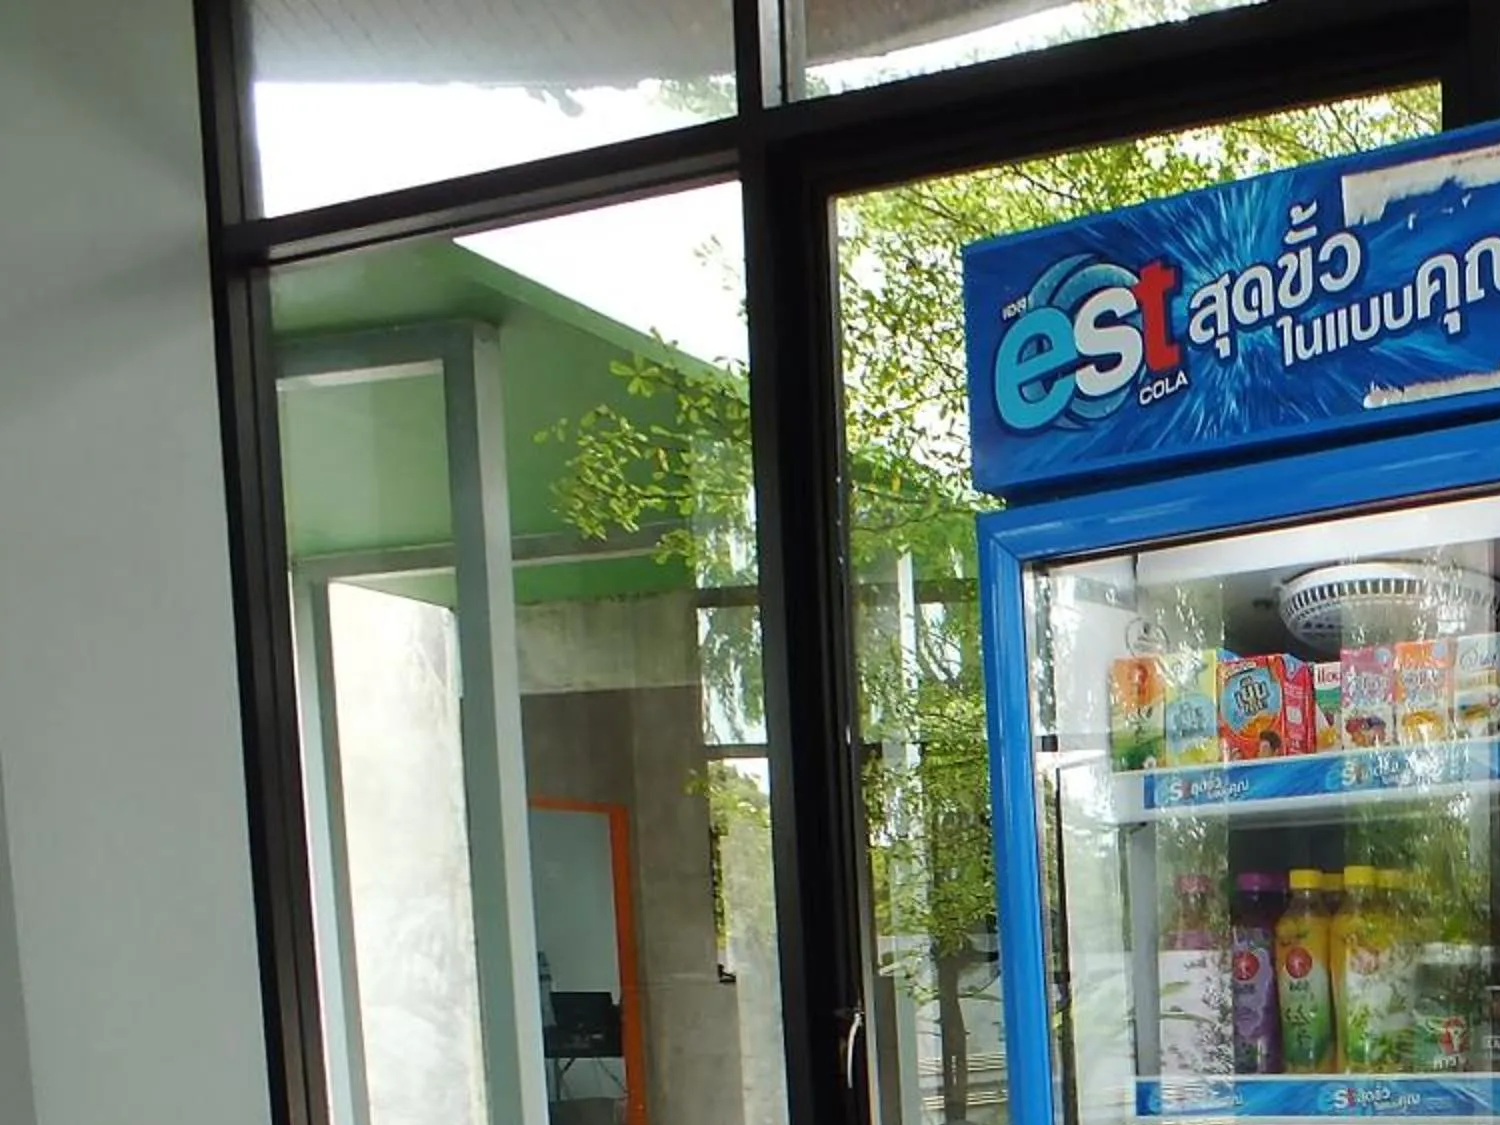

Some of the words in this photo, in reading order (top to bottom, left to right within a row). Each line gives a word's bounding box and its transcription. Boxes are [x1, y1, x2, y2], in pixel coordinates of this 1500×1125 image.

[995, 259, 1181, 430] est
[1188, 199, 1362, 360] สุดขั้ว
[1138, 369, 1189, 406] COLA
